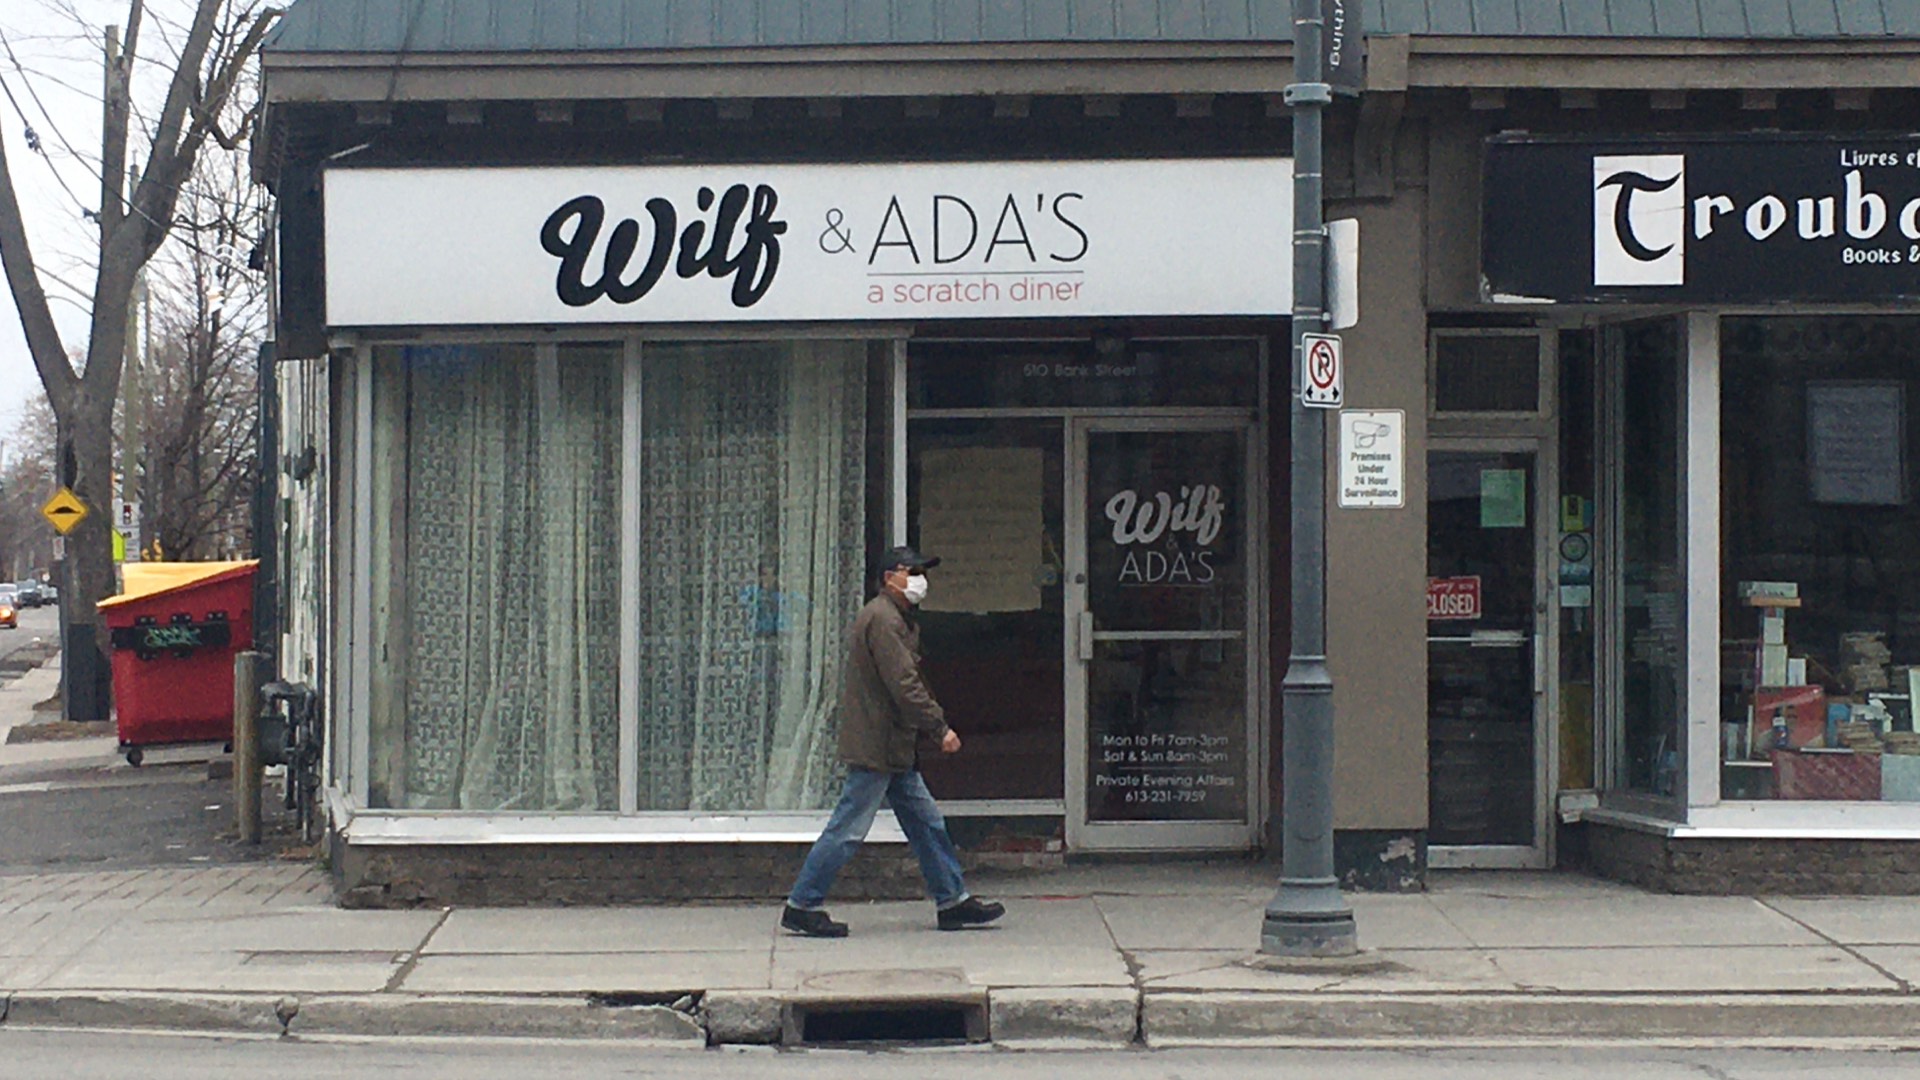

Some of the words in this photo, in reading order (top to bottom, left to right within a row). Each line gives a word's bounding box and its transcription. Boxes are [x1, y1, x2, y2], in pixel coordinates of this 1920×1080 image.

[1841, 148, 1899, 167] Livres
[539, 183, 788, 308] Wilf
[818, 207, 857, 255] &
[868, 192, 1089, 265] ADA'S
[1842, 246, 1902, 265] Books
[867, 283, 884, 304] a
[893, 276, 1000, 303] scratch
[1009, 276, 1085, 301] diner
[1023, 363, 1049, 377] 610
[1054, 363, 1089, 377] Bank
[1094, 363, 1137, 377] Street
[1350, 451, 1392, 461] Premises
[1357, 464, 1384, 474] Under
[1354, 476, 1365, 486] 24
[1367, 476, 1389, 486] Hour
[1344, 488, 1398, 498] Surveillance
[1105, 484, 1225, 546] Wilf
[1118, 550, 1214, 583] ADA'S
[1102, 735, 1132, 747] Mon
[1135, 735, 1149, 747] to
[1151, 734, 1164, 746] Fri
[1103, 750, 1125, 762] Sat
[1127, 751, 1138, 762] &
[1140, 750, 1164, 762] Sun
[1095, 774, 1140, 787] Private
[1143, 774, 1193, 789] Evening
[1196, 774, 1235, 787] Affairs
